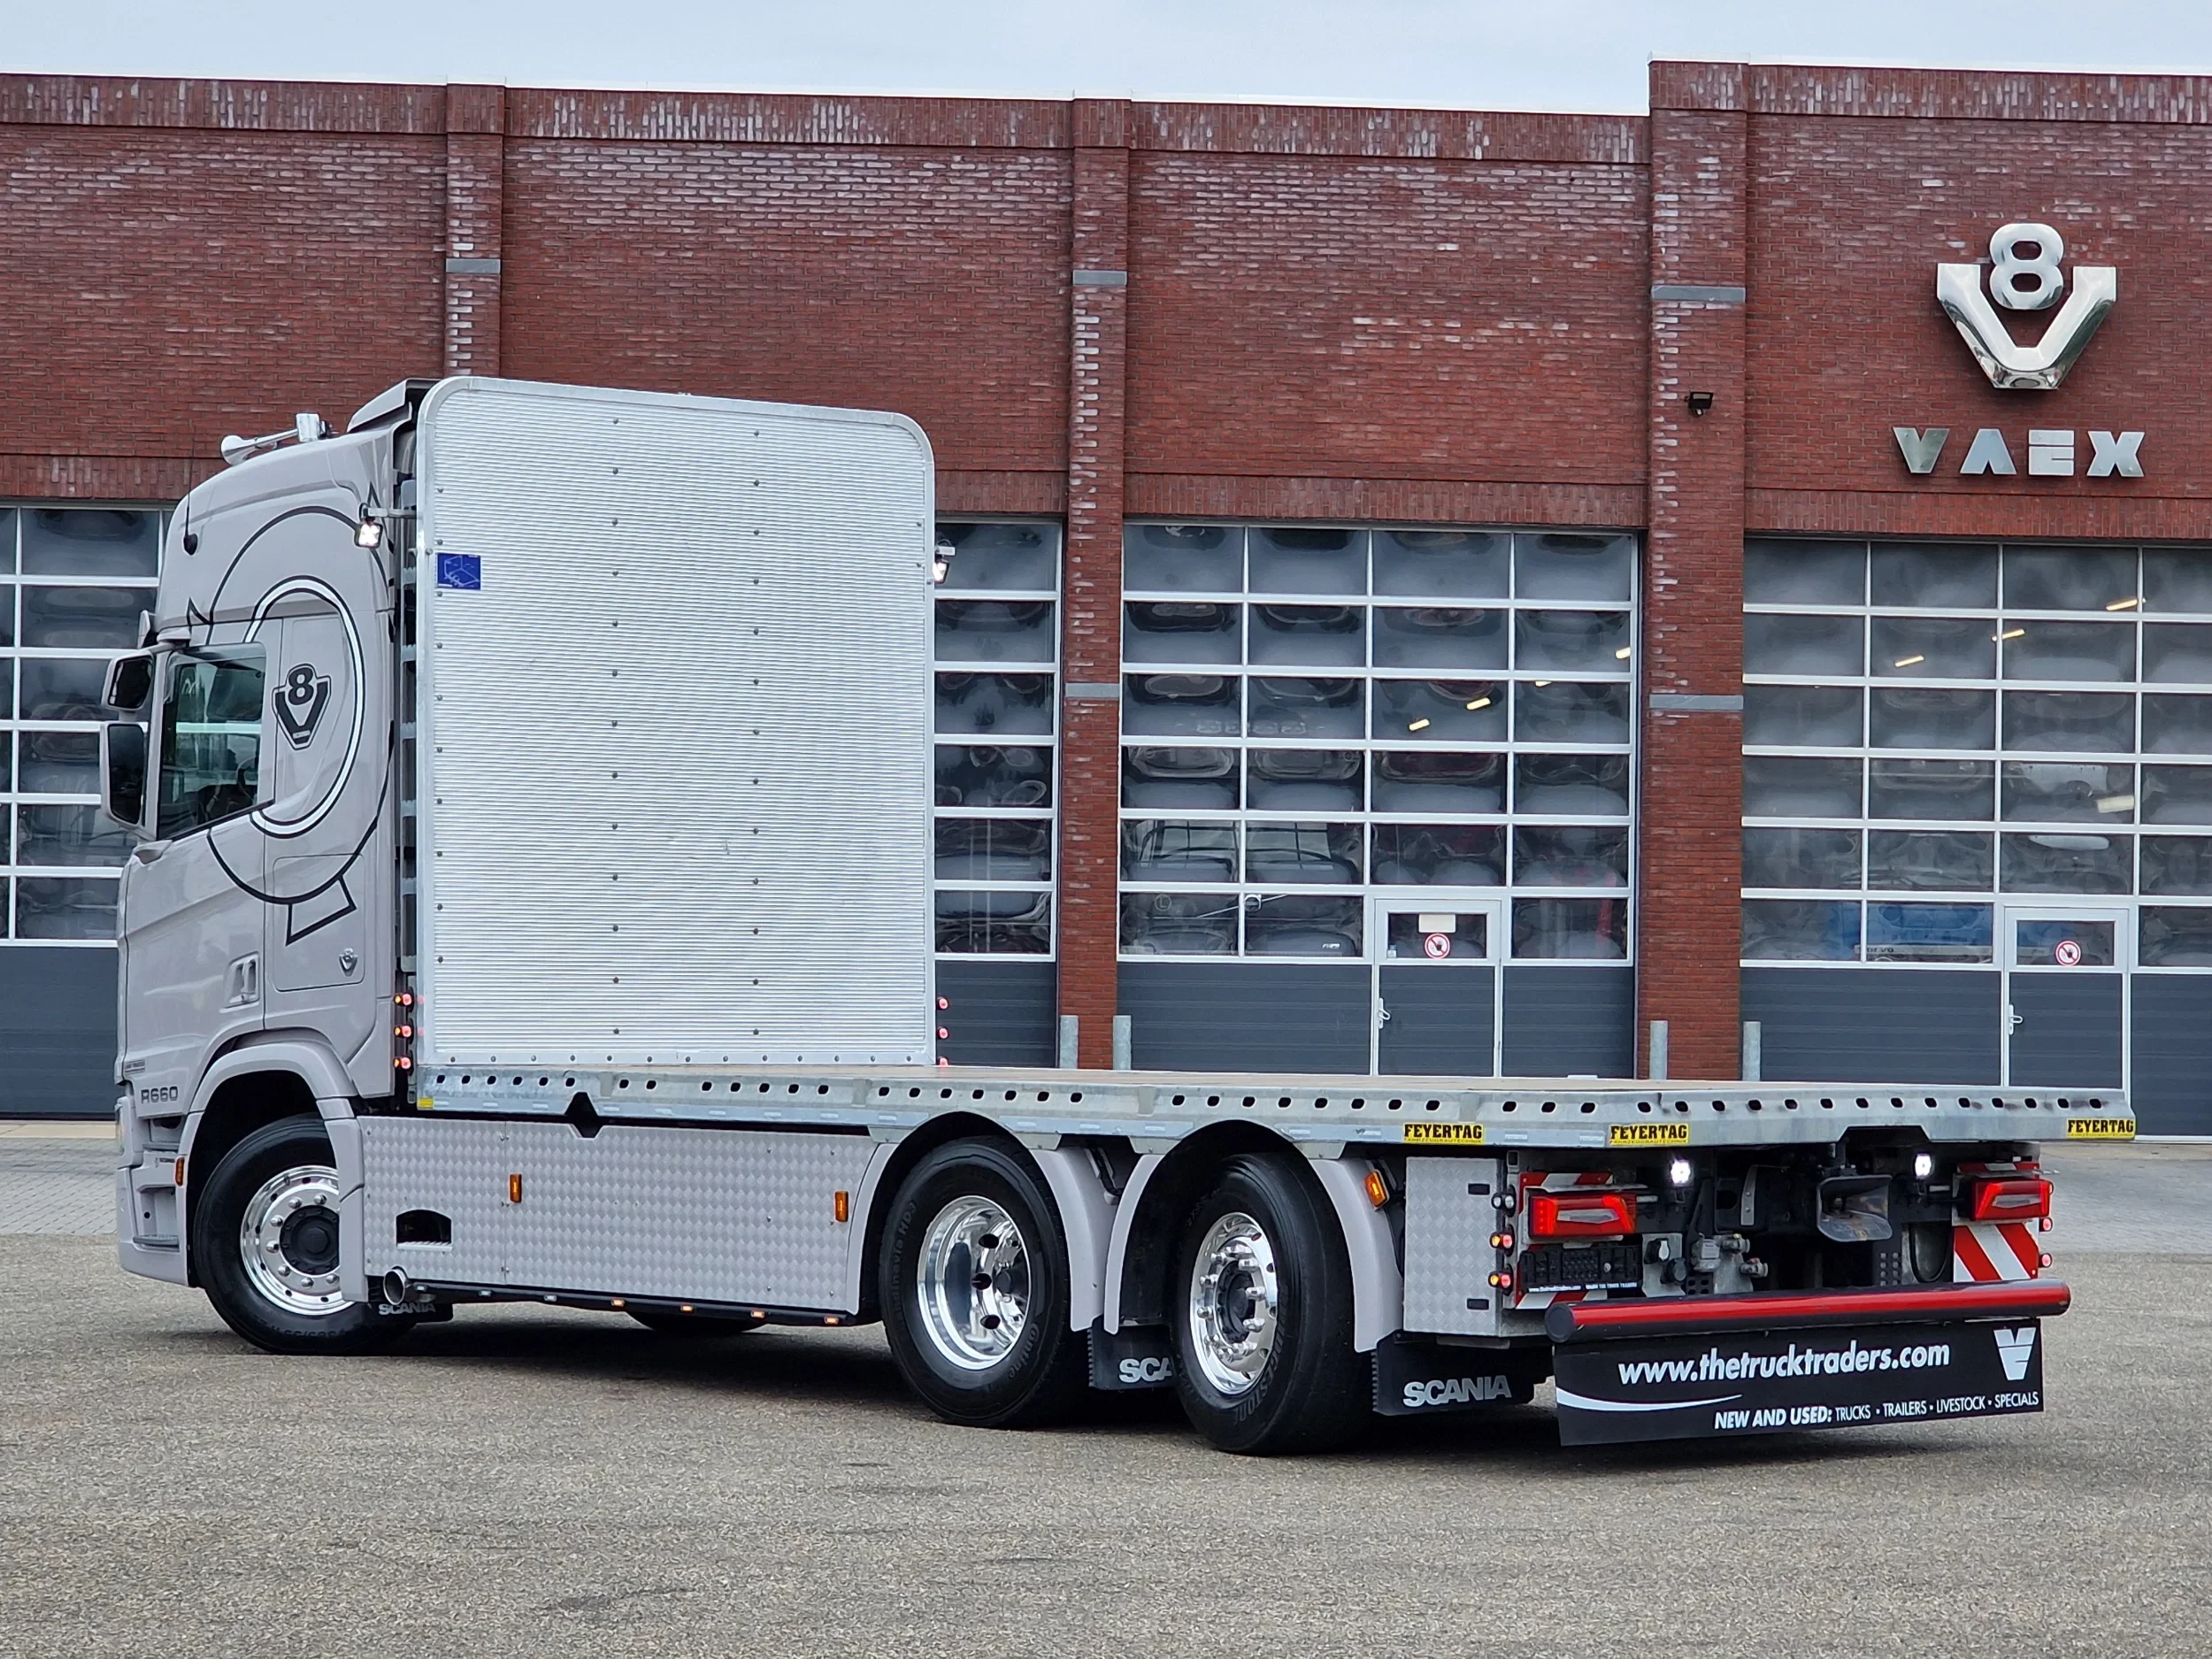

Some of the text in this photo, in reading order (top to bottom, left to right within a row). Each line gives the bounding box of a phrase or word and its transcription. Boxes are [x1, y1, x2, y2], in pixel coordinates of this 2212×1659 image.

[1893, 427, 2145, 477] VAEX
[141, 1087, 178, 1104] R660
[1404, 1124, 1482, 1139] FEYERTAG
[1610, 1125, 1687, 1140] FEYERTAG
[2068, 1119, 2134, 1133] FEYERTAG
[379, 1302, 436, 1315] SCANIA
[1119, 1357, 1171, 1383] SCA
[1618, 1340, 1950, 1385] www.thetrucktraders.com
[1403, 1375, 1512, 1407] SCANIA
[1714, 1392, 2039, 1430] NEW AND USED: TRUCKS TRAILERS LIVESTOCK SPECIALS
